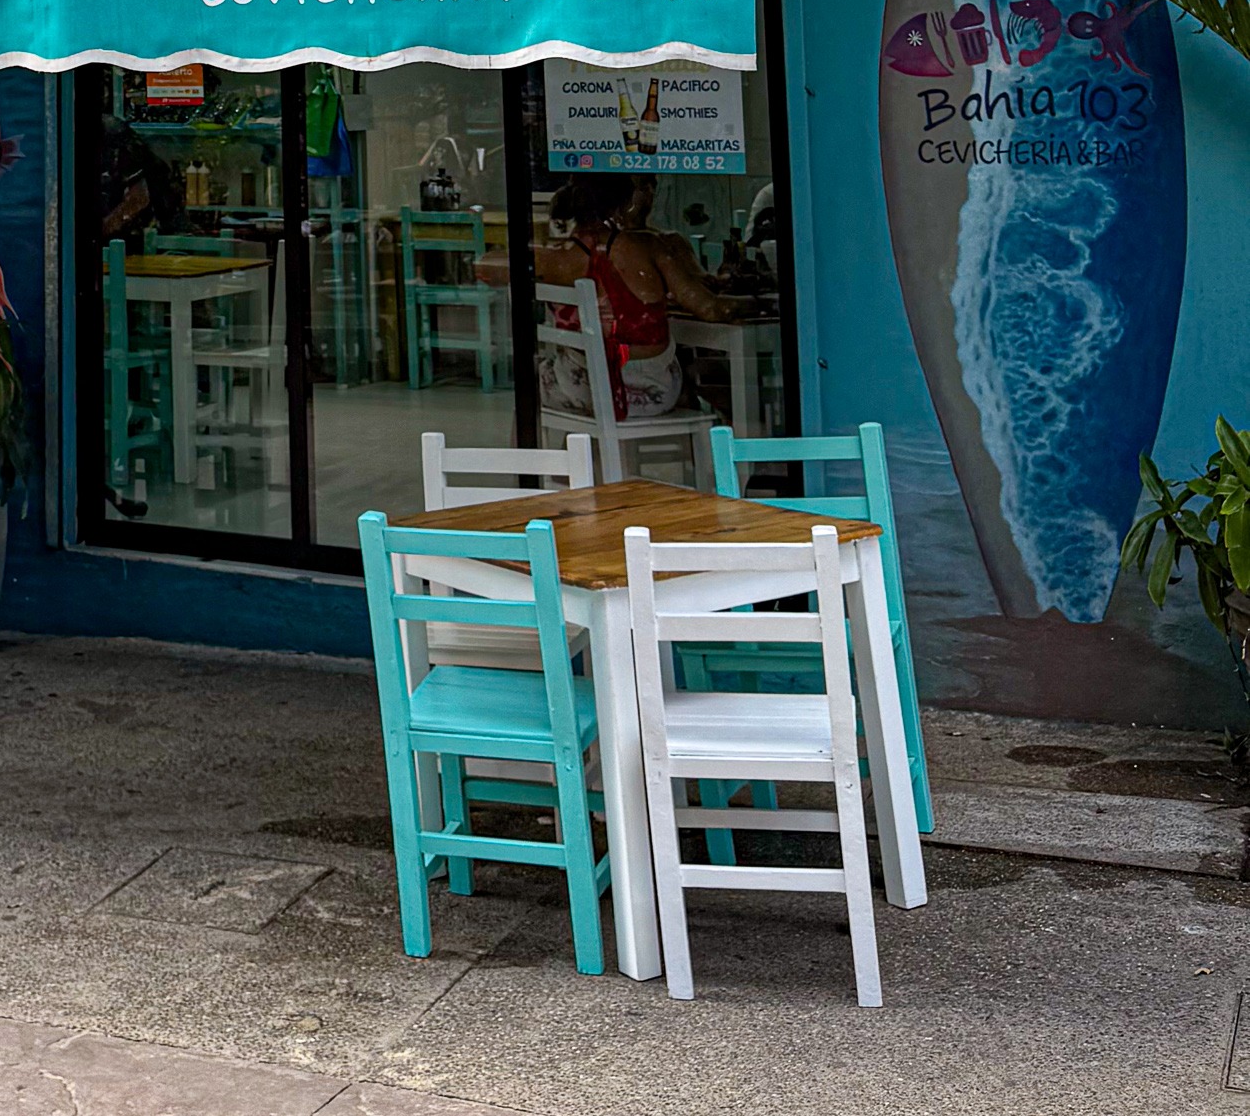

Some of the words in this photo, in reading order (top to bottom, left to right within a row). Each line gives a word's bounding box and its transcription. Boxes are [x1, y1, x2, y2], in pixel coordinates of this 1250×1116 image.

[562, 81, 614, 94] CORONA
[661, 80, 721, 92] PACIFICO
[916, 68, 1057, 132] Bahía
[1067, 79, 1150, 132] 103
[568, 106, 618, 119] DAIQUIRI
[660, 107, 718, 119] SMOTHIES
[579, 139, 623, 151] COLADA
[660, 139, 740, 152] MARGARITAS
[624, 155, 651, 170] 322
[657, 156, 677, 170] 178
[682, 156, 700, 170] 08
[705, 156, 725, 171] 52
